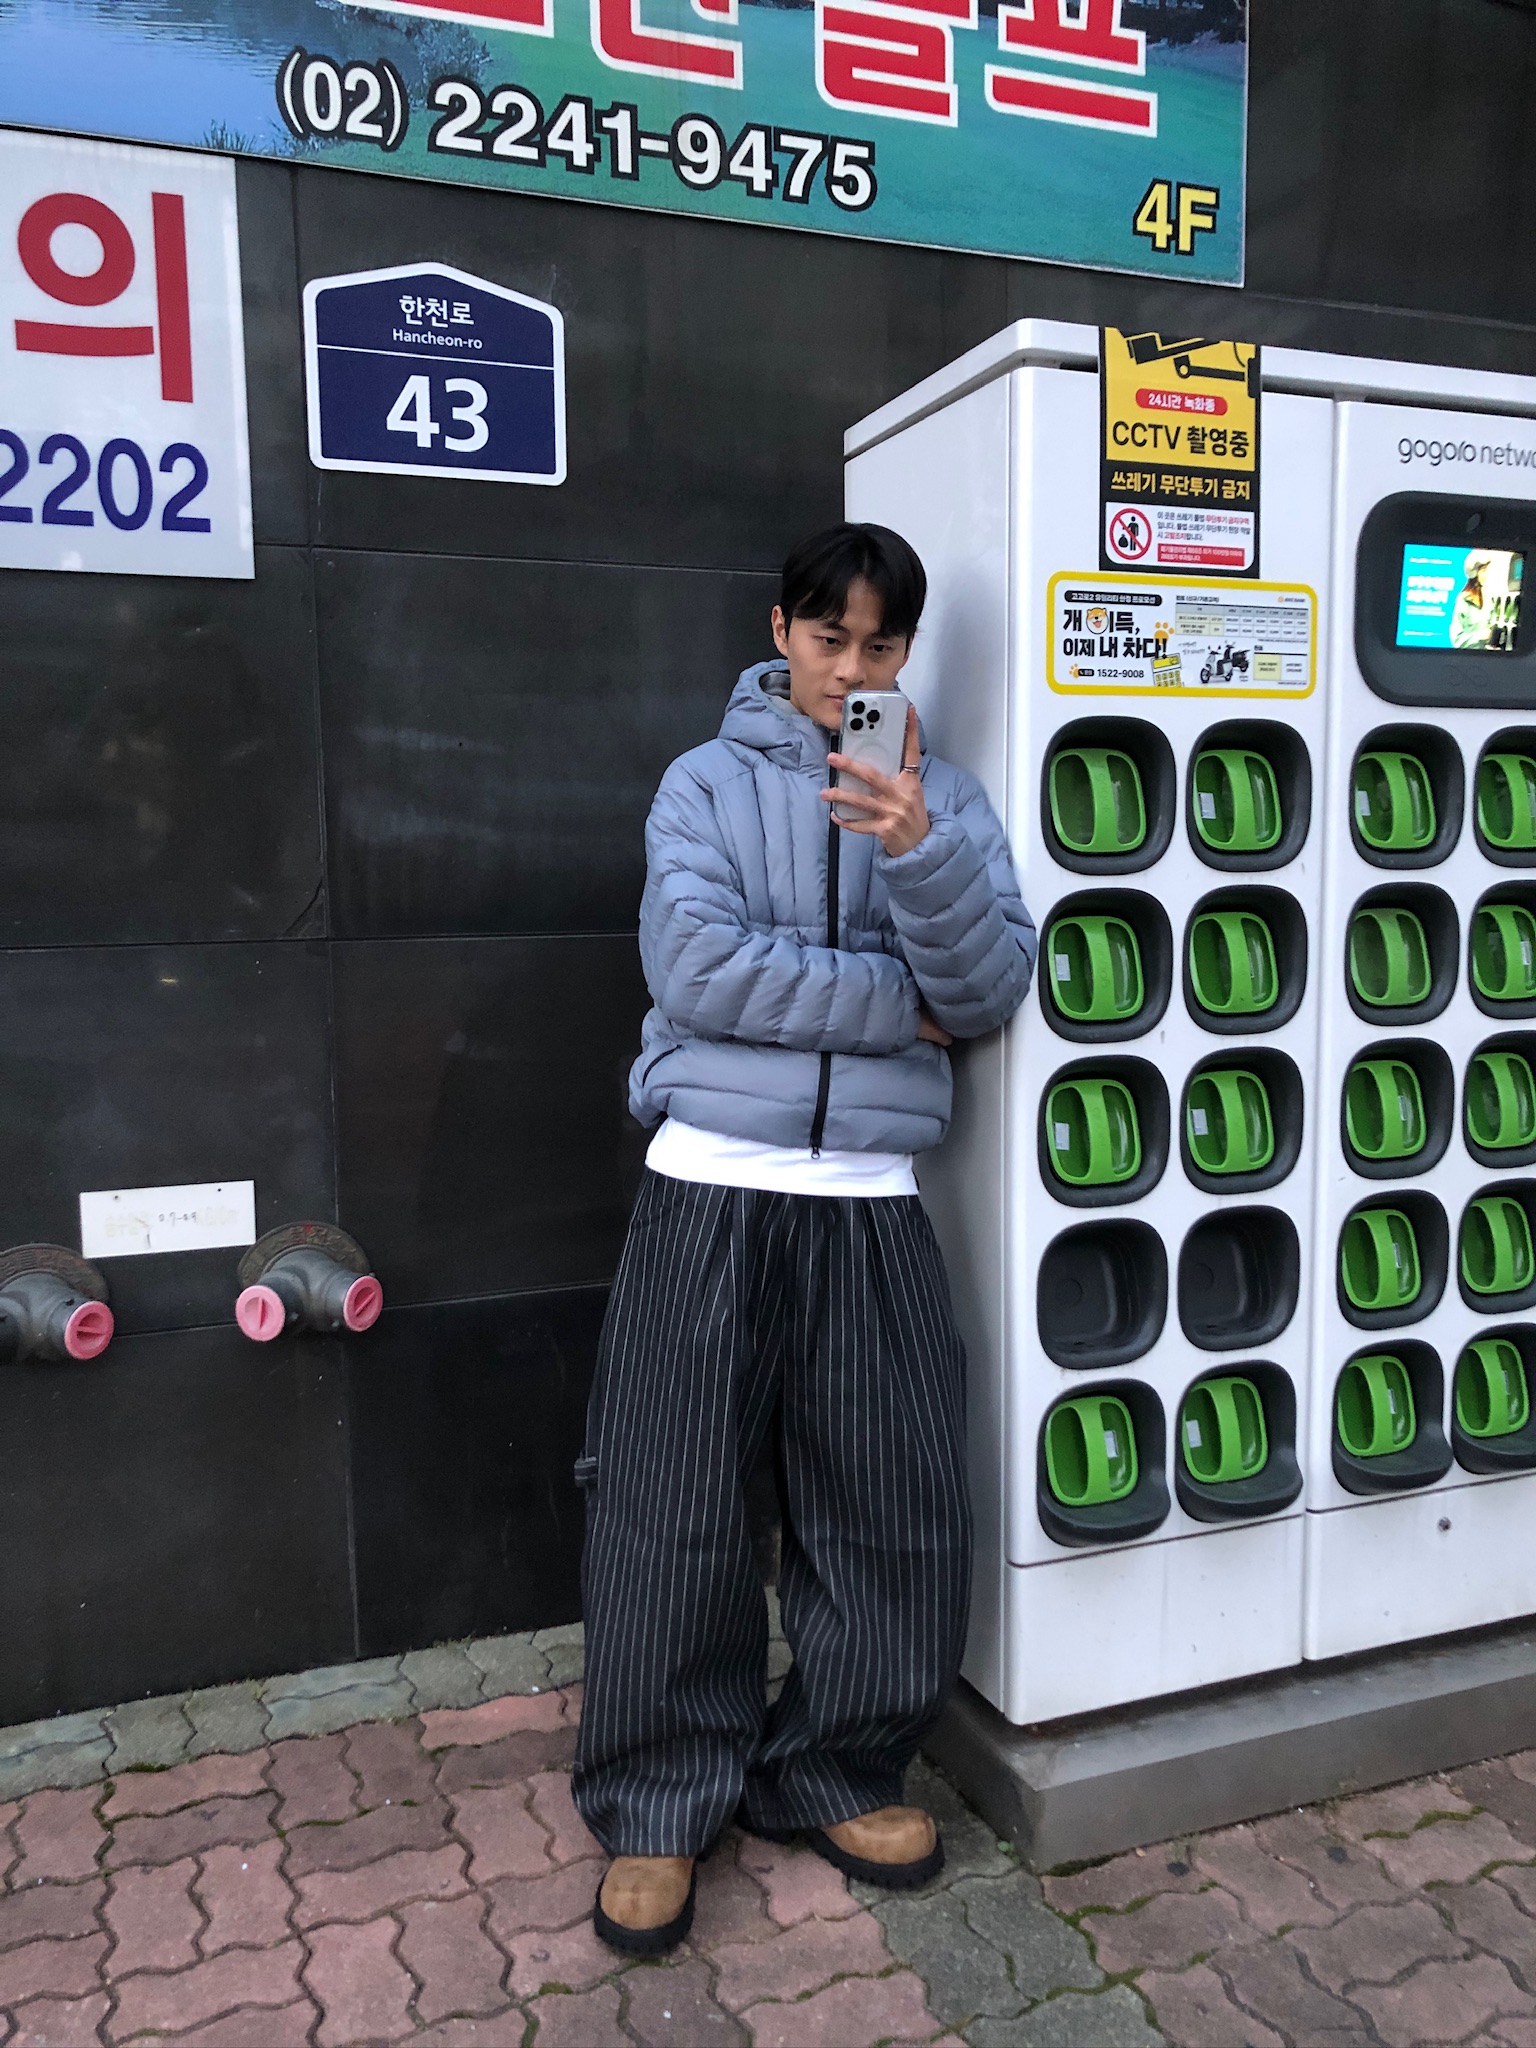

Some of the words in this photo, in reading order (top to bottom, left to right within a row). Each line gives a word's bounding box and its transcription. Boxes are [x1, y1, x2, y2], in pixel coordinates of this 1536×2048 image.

[283, 51, 402, 143] (02)
[433, 80, 874, 208] 2241-9475
[1136, 183, 1217, 252] 4F
[14, 192, 193, 403] 의
[399, 294, 475, 328] 한천로
[392, 328, 483, 350] Hancheon-ro
[385, 374, 490, 452] 43
[1148, 393, 1181, 409] 24시간
[1112, 421, 1181, 450] CCTV
[1187, 425, 1250, 458] 촬영중
[1398, 438, 1476, 466] gogoro
[1111, 471, 1156, 493] 쓰레기
[1159, 474, 1219, 498] 무단투기
[1221, 479, 1251, 500] 금지
[1063, 638, 1095, 657] 이제
[1099, 636, 1118, 658] 내
[1122, 637, 1168, 660] 차다!
[1097, 669, 1145, 678] 1522-9008
